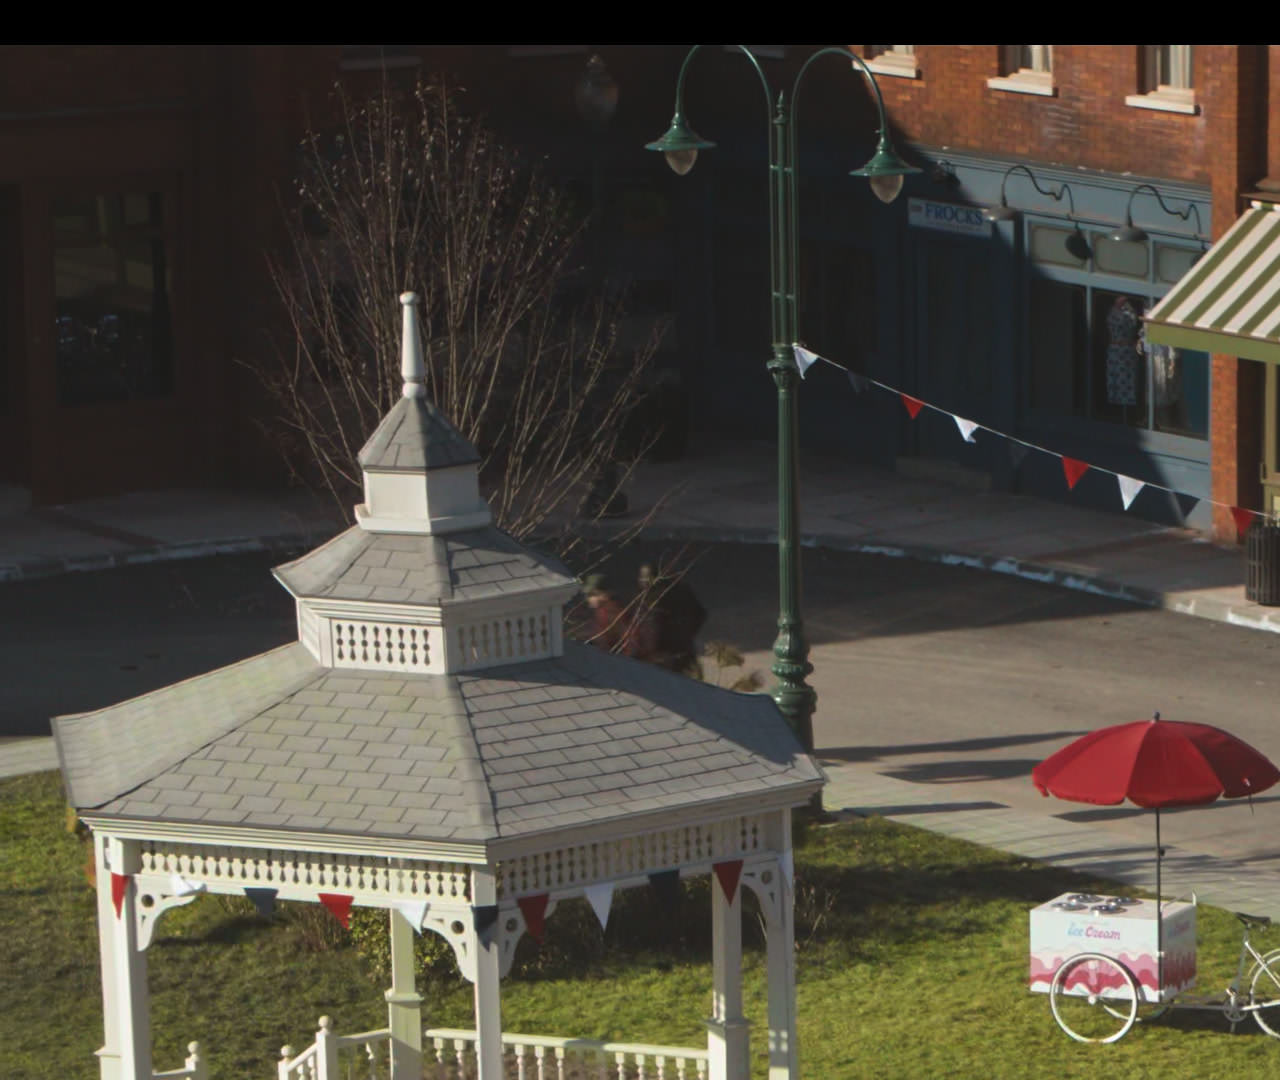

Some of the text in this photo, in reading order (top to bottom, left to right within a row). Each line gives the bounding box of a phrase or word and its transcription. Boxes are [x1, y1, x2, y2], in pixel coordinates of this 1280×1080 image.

[925, 202, 985, 226] FROCKS
[1067, 921, 1084, 937] Ice
[1085, 925, 1121, 940] Cream
